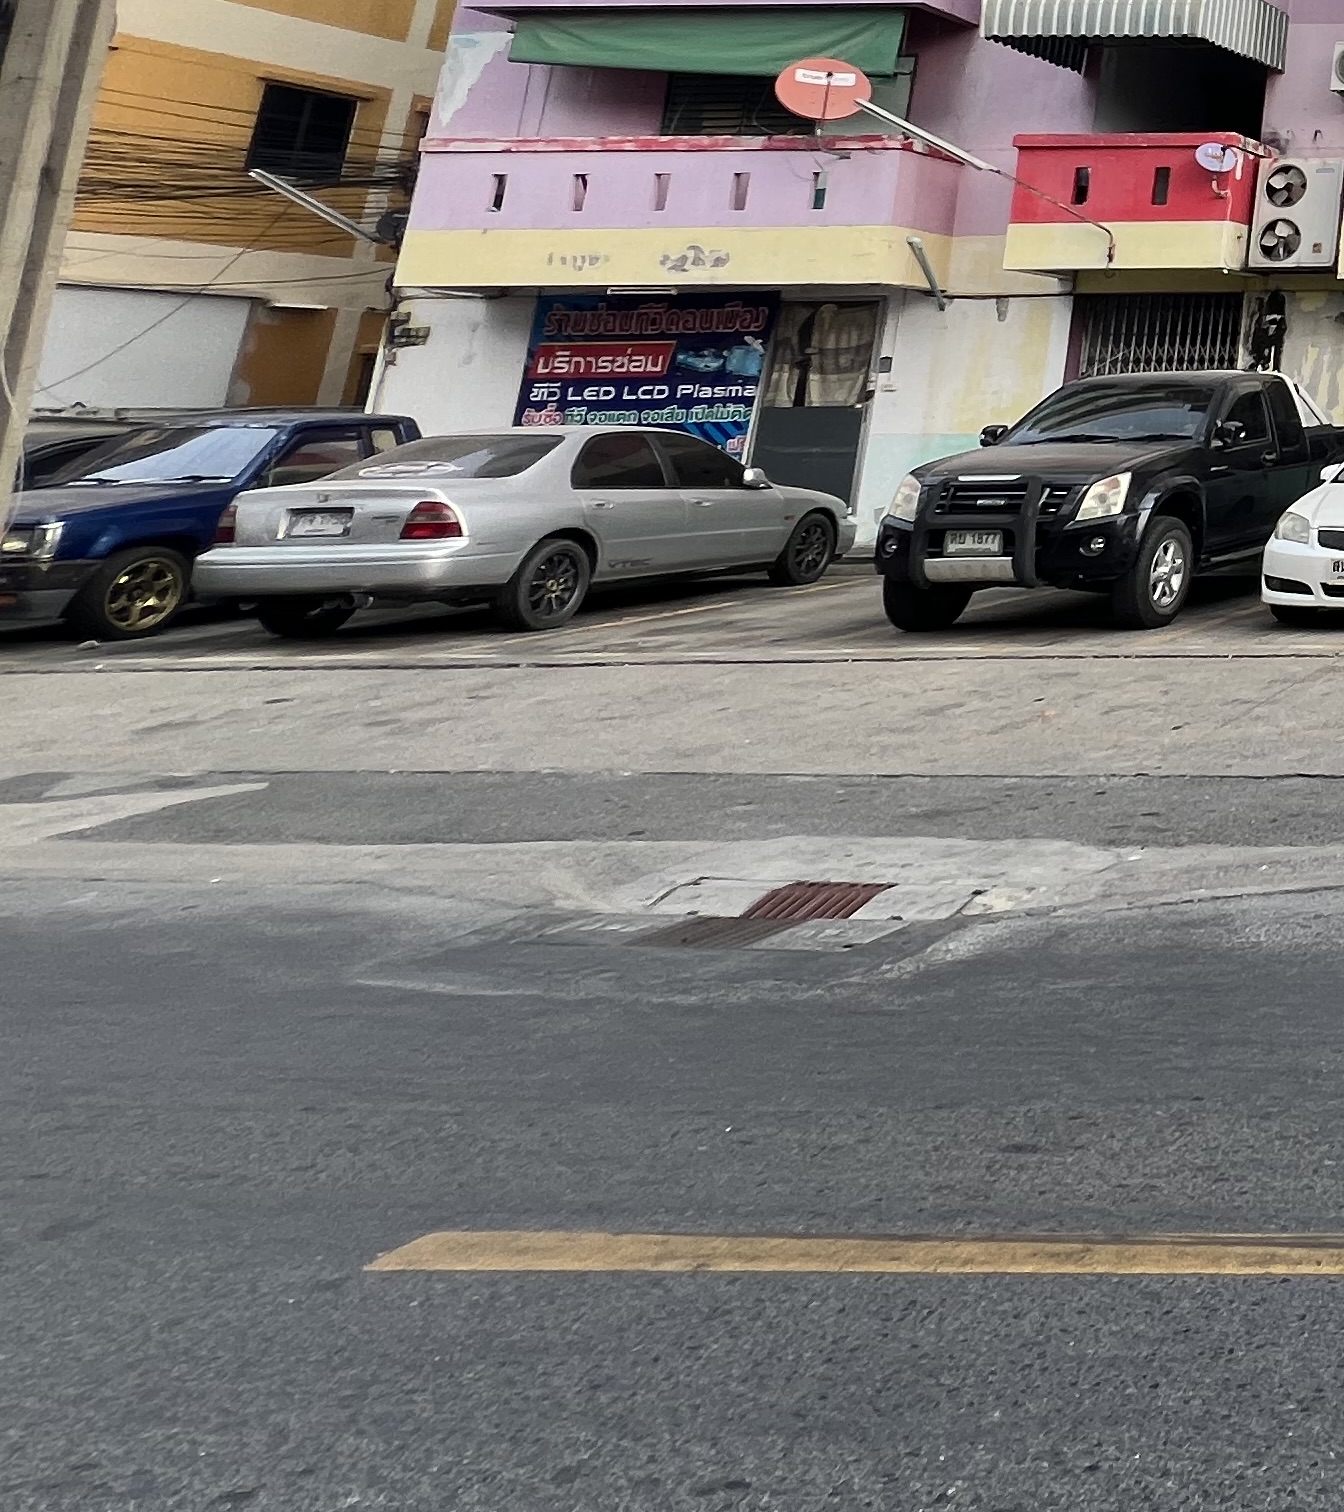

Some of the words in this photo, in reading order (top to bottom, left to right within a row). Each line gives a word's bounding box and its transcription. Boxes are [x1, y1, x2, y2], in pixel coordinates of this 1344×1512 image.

[536, 348, 664, 374] บริการซ่อม
[567, 386, 616, 401] LED
[622, 385, 670, 400] LCD
[676, 383, 757, 399] Plasma
